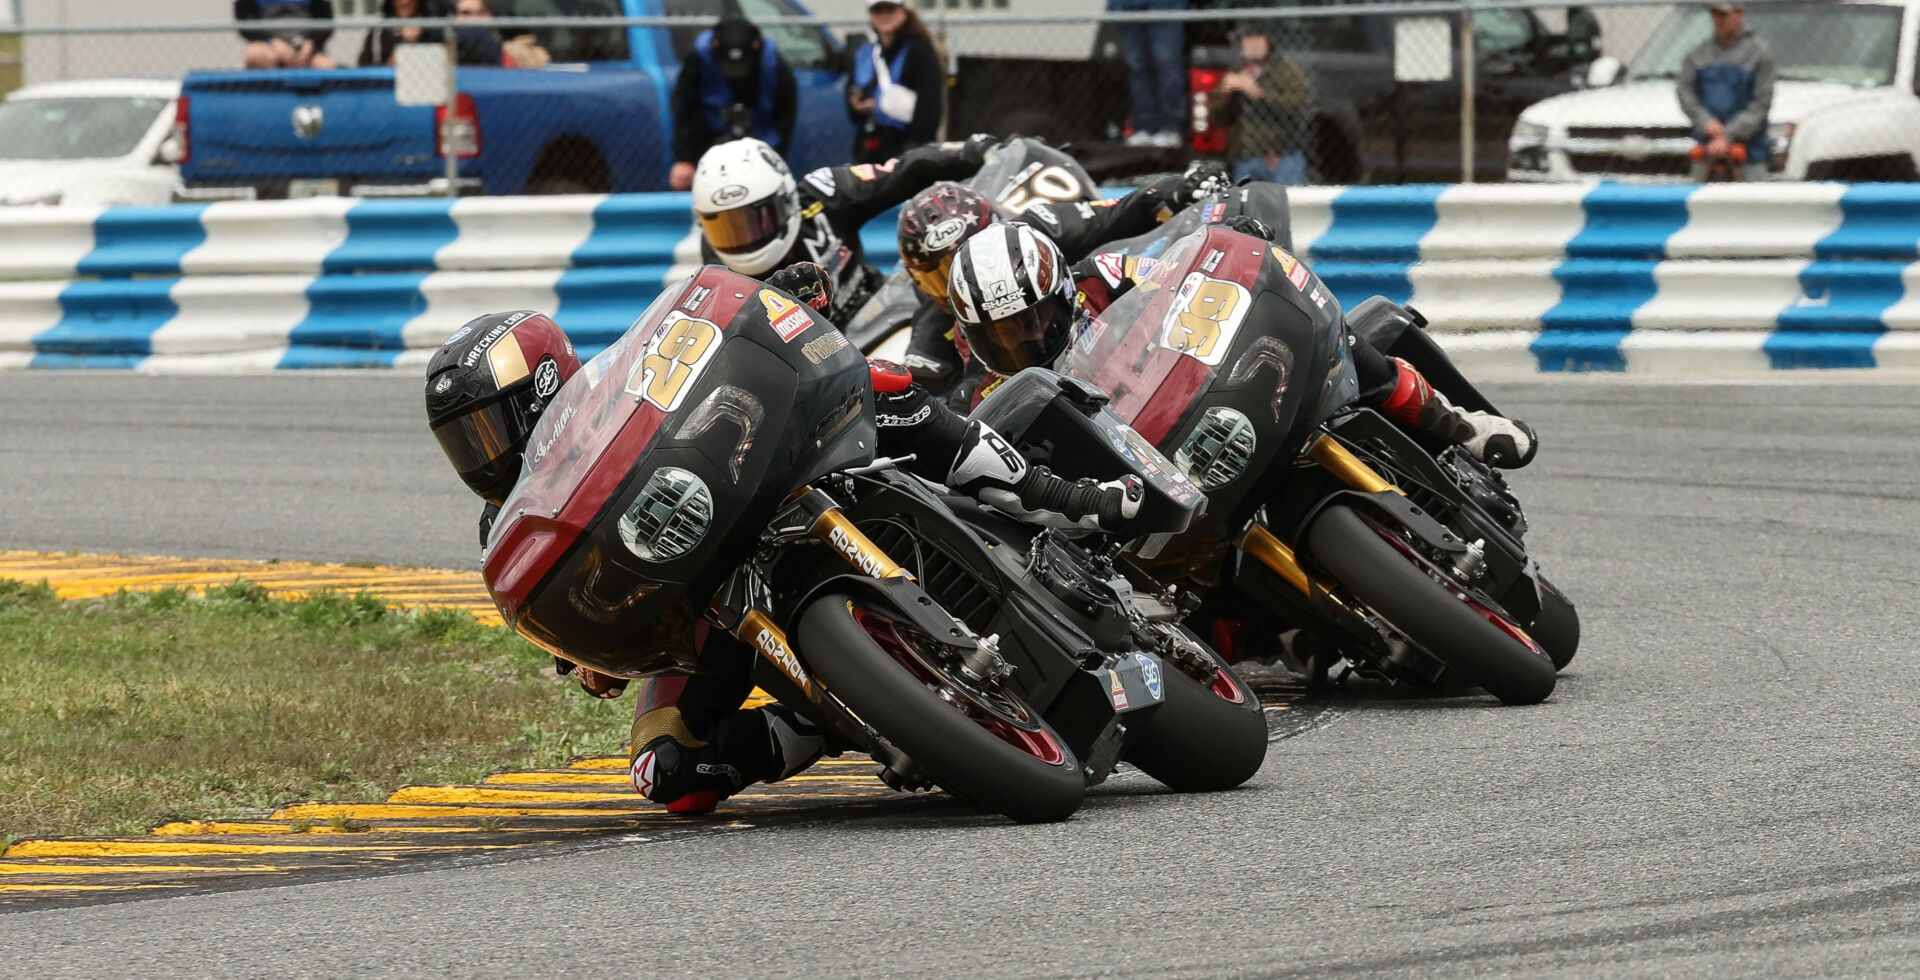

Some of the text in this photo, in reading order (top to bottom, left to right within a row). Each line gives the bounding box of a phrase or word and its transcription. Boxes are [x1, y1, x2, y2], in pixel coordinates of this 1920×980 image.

[717, 186, 745, 200] Arai
[931, 223, 960, 243] Arai
[981, 287, 1027, 311] SHARK
[1167, 280, 1241, 357] 99
[463, 324, 507, 368] WRECKING
[504, 311, 526, 327] CREW
[627, 318, 716, 410] 29
[828, 524, 883, 579] DUNLOP
